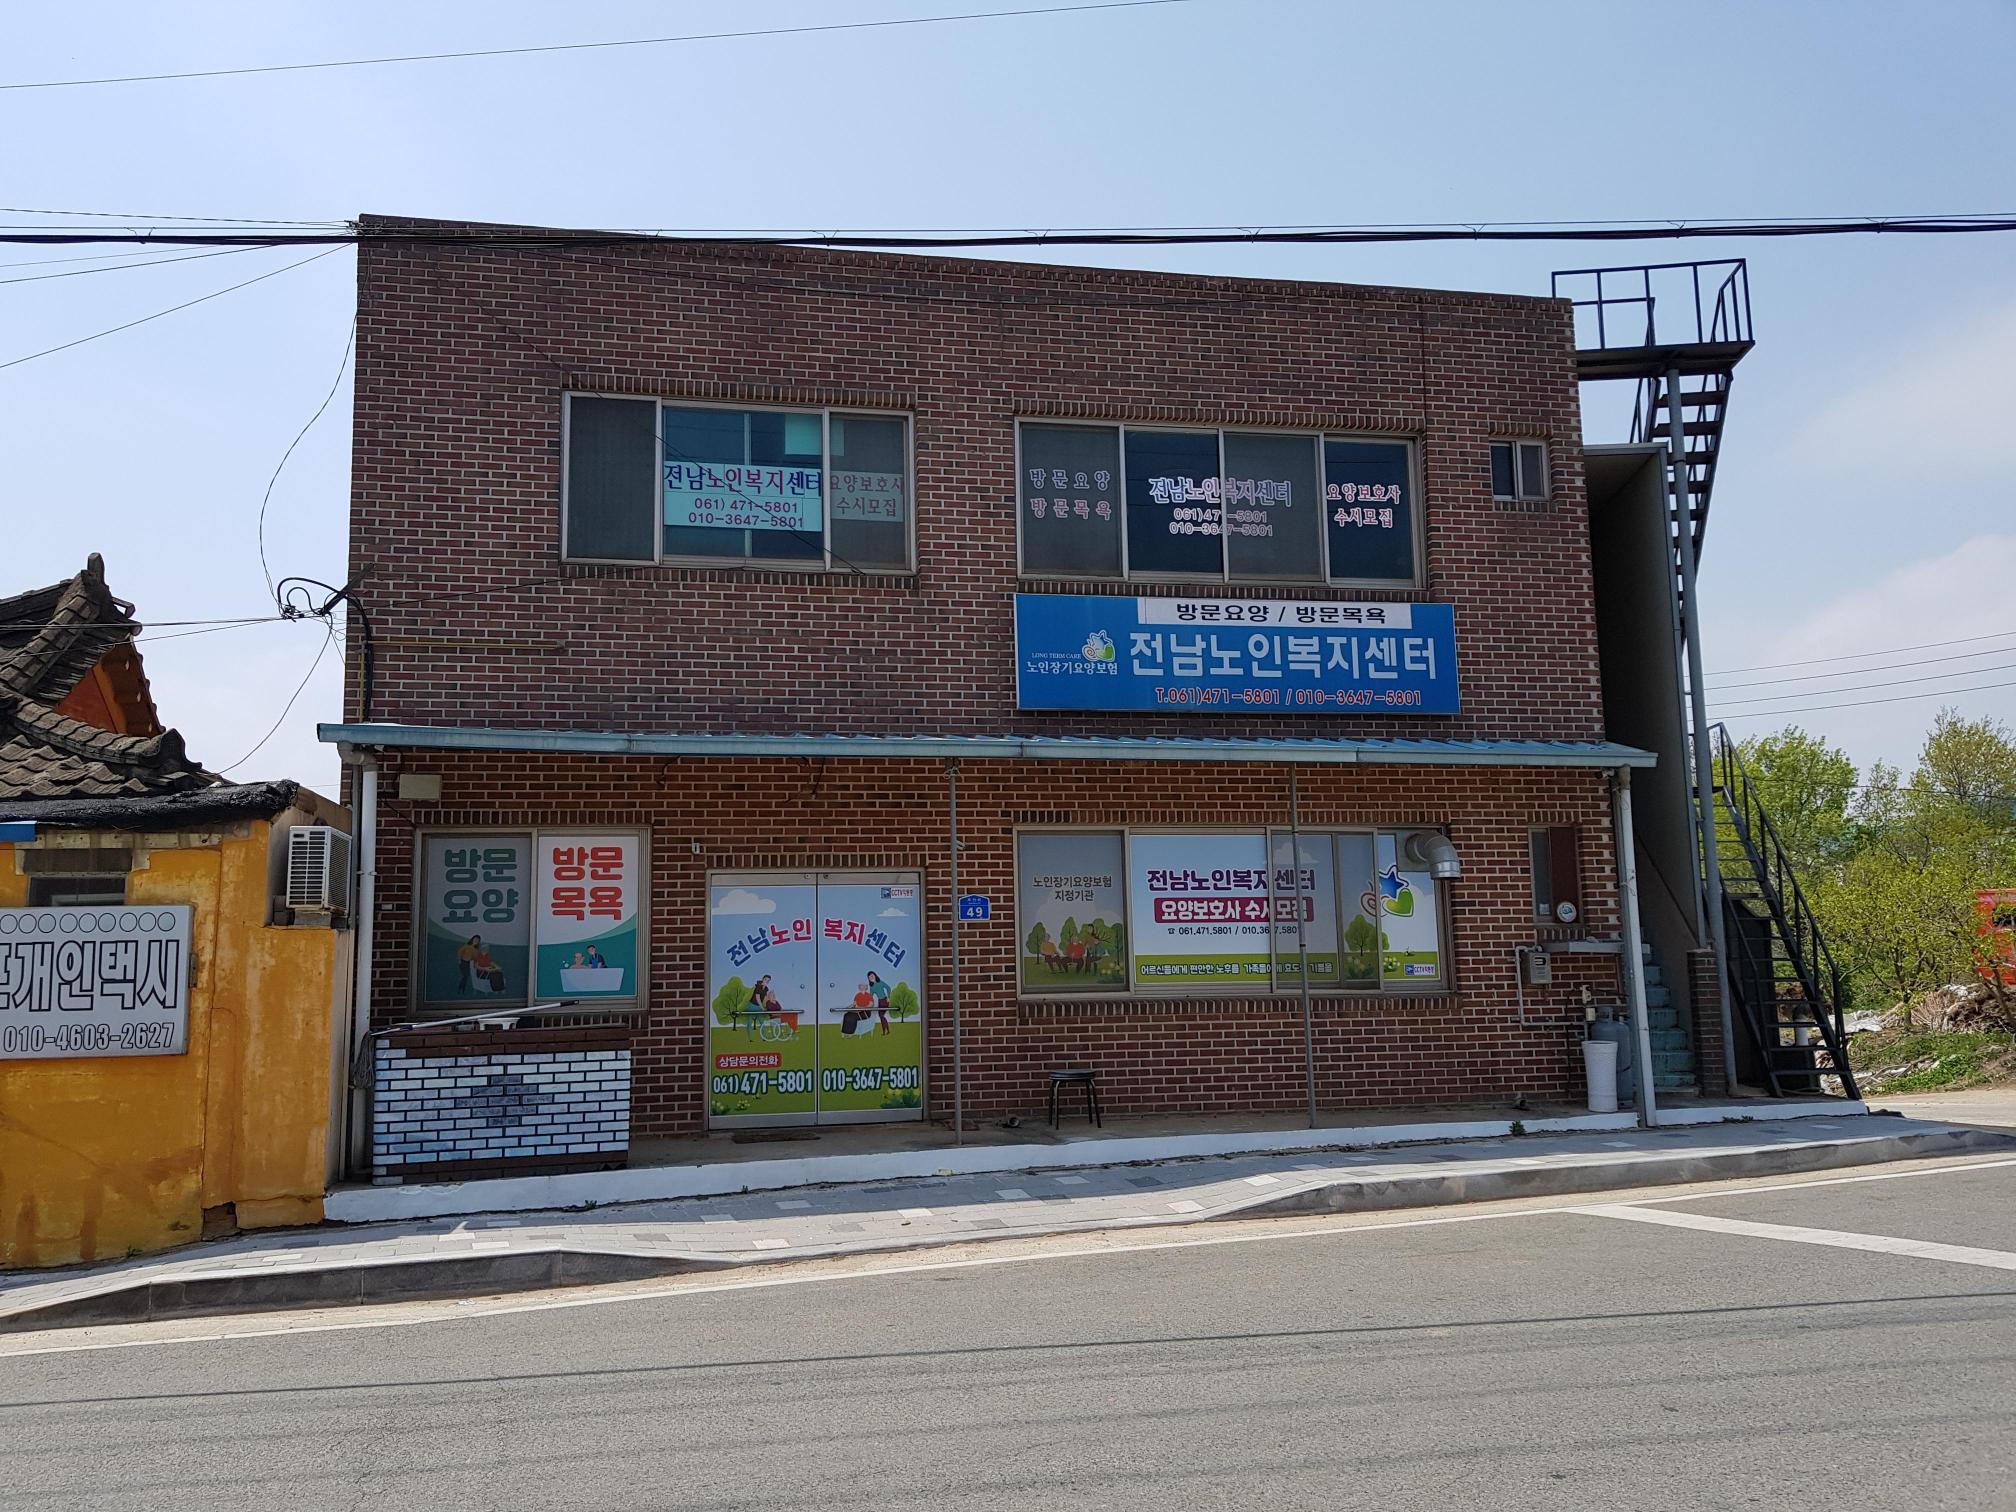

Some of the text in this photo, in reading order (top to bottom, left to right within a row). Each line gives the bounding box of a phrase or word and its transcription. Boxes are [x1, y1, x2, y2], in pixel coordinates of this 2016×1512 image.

[664, 464, 822, 497] 전남노인복지센터
[1029, 468, 1110, 491] 방문요양
[1148, 476, 1292, 507] 전남노인복지센터
[1326, 483, 1402, 504] 요양보호사
[694, 498, 798, 514] 061) 471-5801
[836, 496, 897, 517] 수시모집
[1030, 498, 1111, 521] 방문목욕
[1173, 507, 1268, 523] 061)47-5801
[688, 511, 804, 528] 010-3647-5801
[1334, 507, 1393, 528] 수시모집
[1177, 603, 1270, 623] 방문요양
[1296, 606, 1386, 624] 방문목욕
[1129, 632, 1437, 680] 전남노인복지센터
[1026, 661, 1118, 675] 노인장기요양보험
[1155, 686, 1280, 705] T.061)471-5801
[1295, 689, 1422, 706] 010-3647-5801
[444, 848, 518, 883] 방문
[552, 846, 624, 881] 방문
[1032, 875, 1112, 888] 노인장기요양보험
[551, 886, 624, 921] 목욕
[1054, 889, 1095, 901] 지정기관
[442, 888, 519, 924] 요양
[966, 906, 983, 917] 49
[1161, 900, 1309, 920] 요양보호사 수모집
[1178, 926, 1232, 935] 061.471.5801
[1241, 926, 1299, 935] 010.367.580
[1140, 964, 1188, 975] 어르신들에게
[1215, 963, 1240, 974] 노후를
[1284, 963, 1303, 973] 효도
[4, 1022, 175, 1052] 010-4603-2627
[719, 1055, 779, 1068] 상담문의전화
[713, 1066, 918, 1094] 061)471-5801 010-3647-5801
